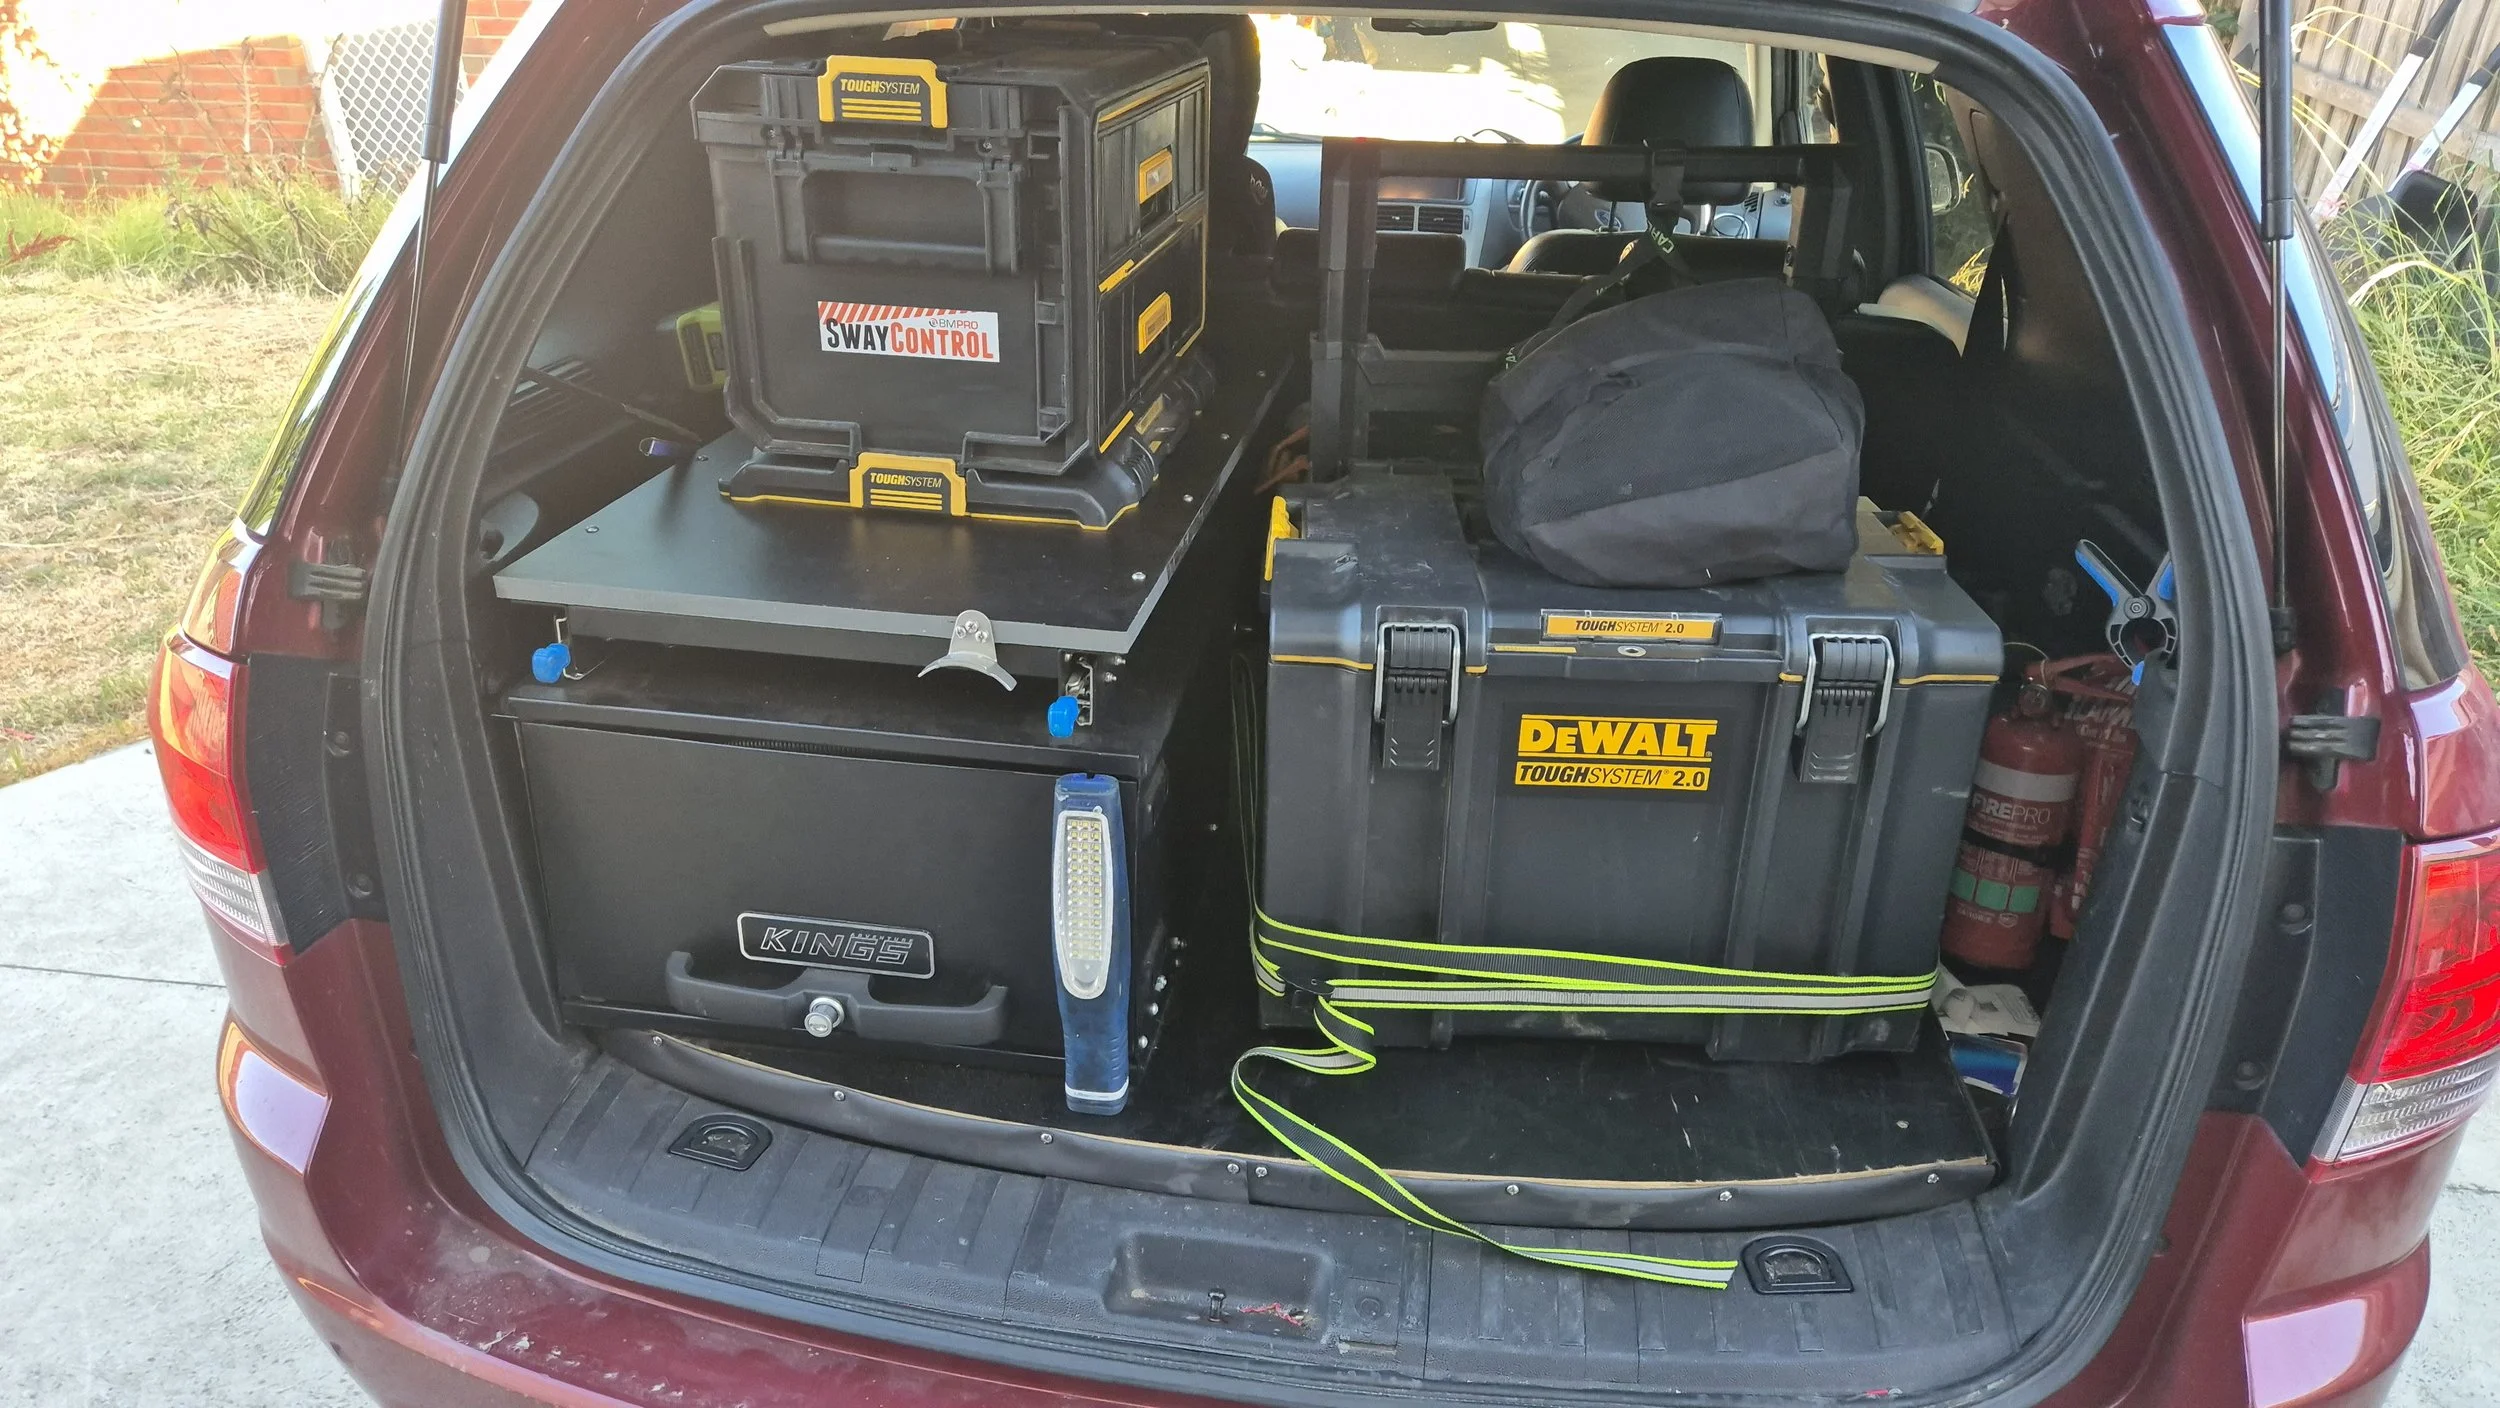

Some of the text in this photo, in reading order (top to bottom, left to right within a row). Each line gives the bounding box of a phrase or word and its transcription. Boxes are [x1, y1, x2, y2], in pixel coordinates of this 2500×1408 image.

[840, 79, 920, 95] TOUGHSYSTEM
[939, 319, 979, 330] BMPRO
[870, 472, 942, 488] TOUGHSYSTEM
[1575, 620, 1685, 634] TOUGHSYSTEM 2.0
[1518, 719, 1718, 757] DEWALT
[1519, 765, 1705, 787] TOUGHSYSTEM 2.0
[1972, 792, 2051, 825] FIREPRO
[760, 926, 913, 965] KINGS
